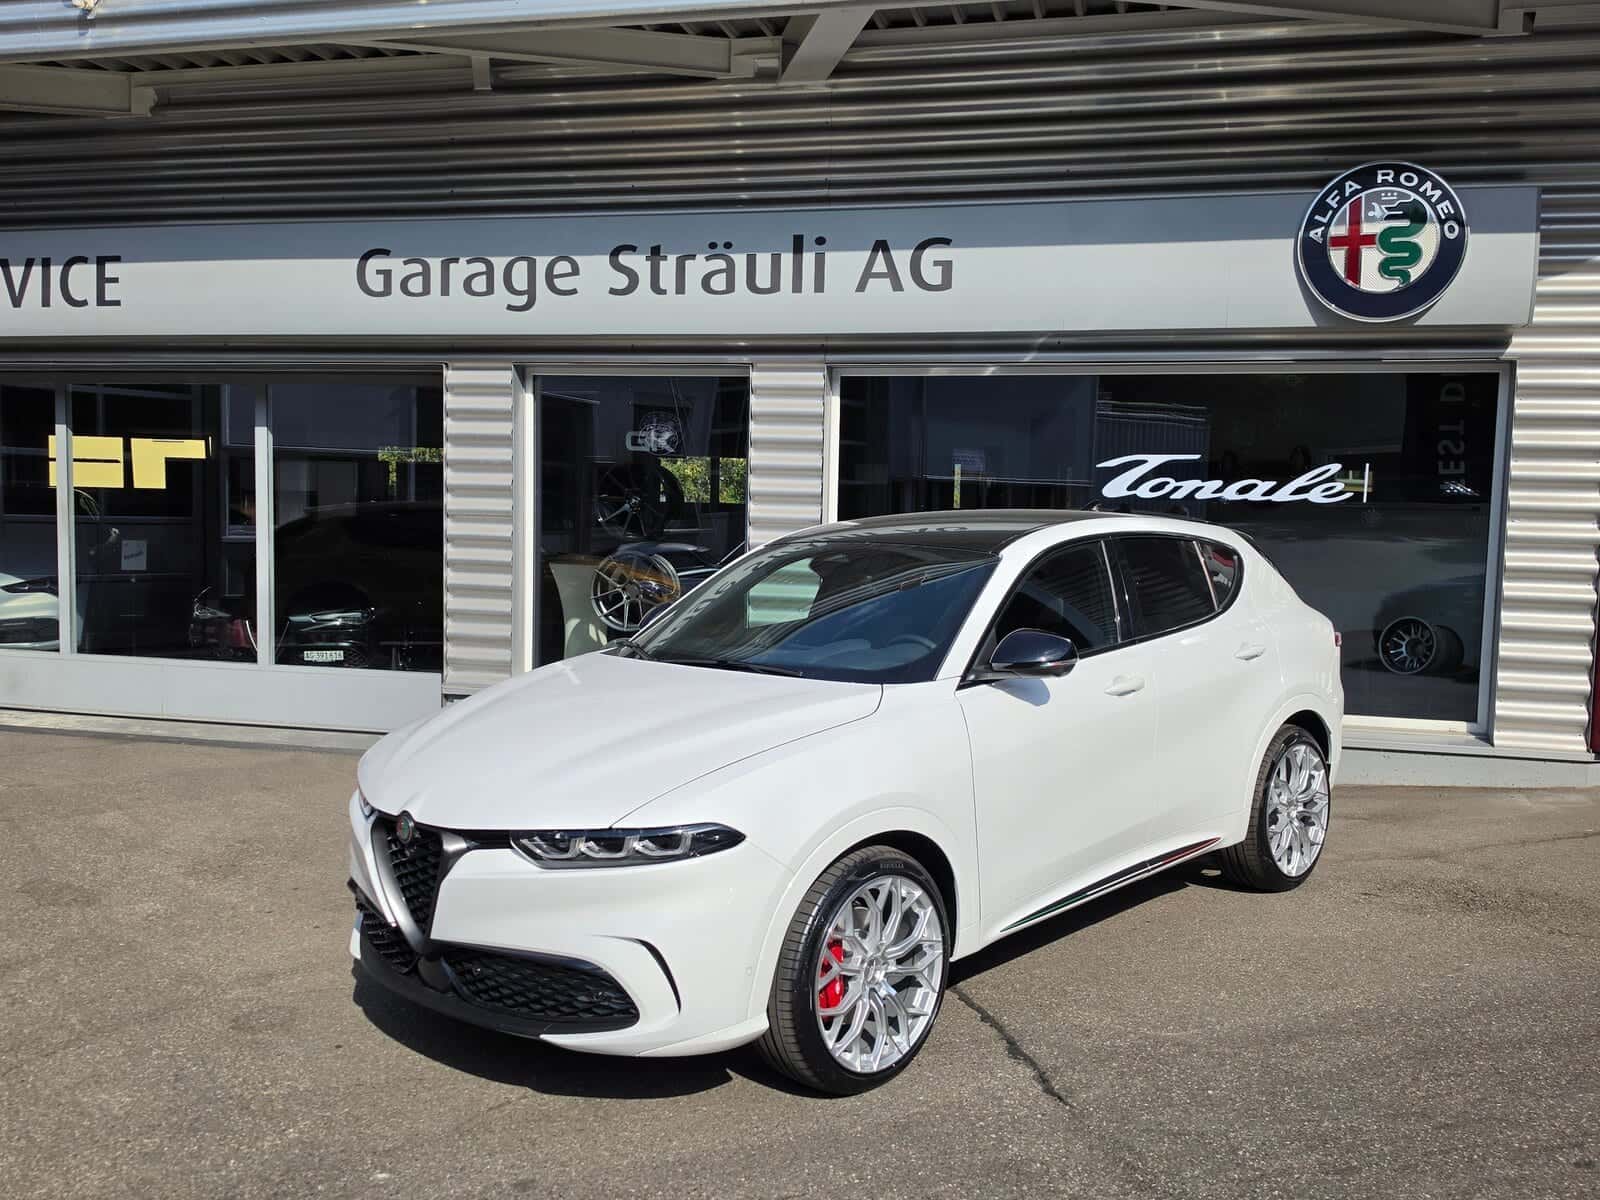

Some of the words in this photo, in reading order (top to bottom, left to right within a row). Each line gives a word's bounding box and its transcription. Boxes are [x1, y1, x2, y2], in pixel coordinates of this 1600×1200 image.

[1309, 180, 1362, 244] ALFA
[1376, 170, 1460, 240] ROMEO
[0, 255, 121, 308] VICE
[356, 248, 581, 312] Garage
[608, 234, 827, 296] Sträuli
[855, 236, 953, 293] AG
[1096, 454, 1354, 503] Tonale
